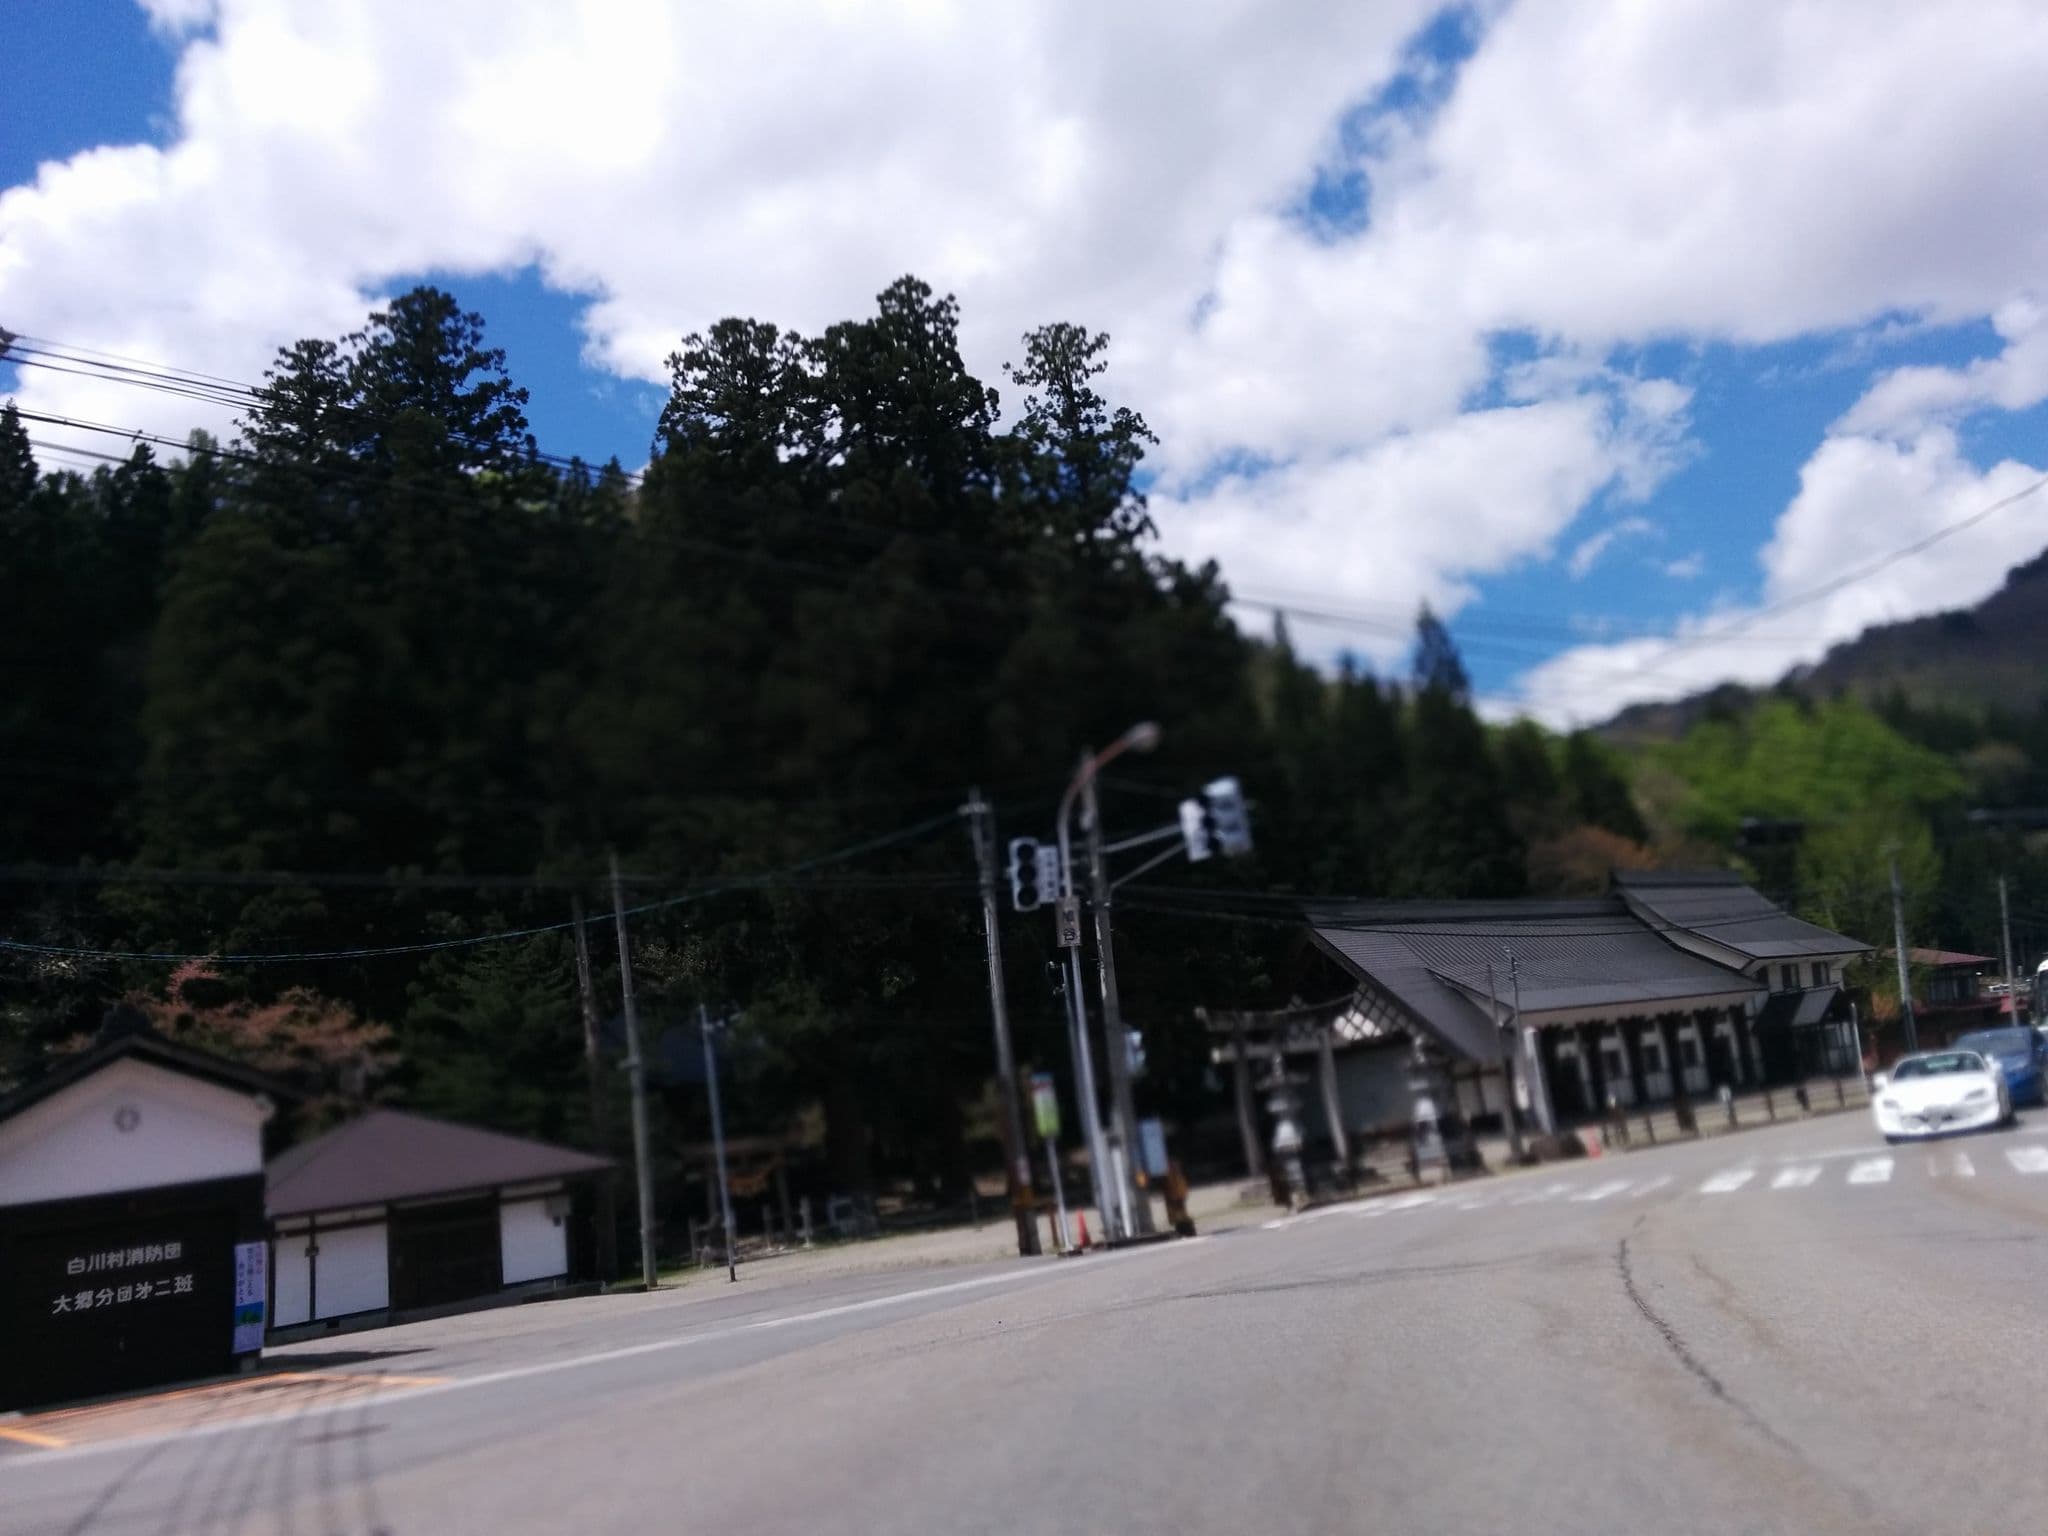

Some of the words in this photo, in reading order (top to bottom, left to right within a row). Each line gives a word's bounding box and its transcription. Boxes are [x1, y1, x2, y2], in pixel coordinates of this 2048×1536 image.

[66, 1241, 182, 1276] 白川村消防団
